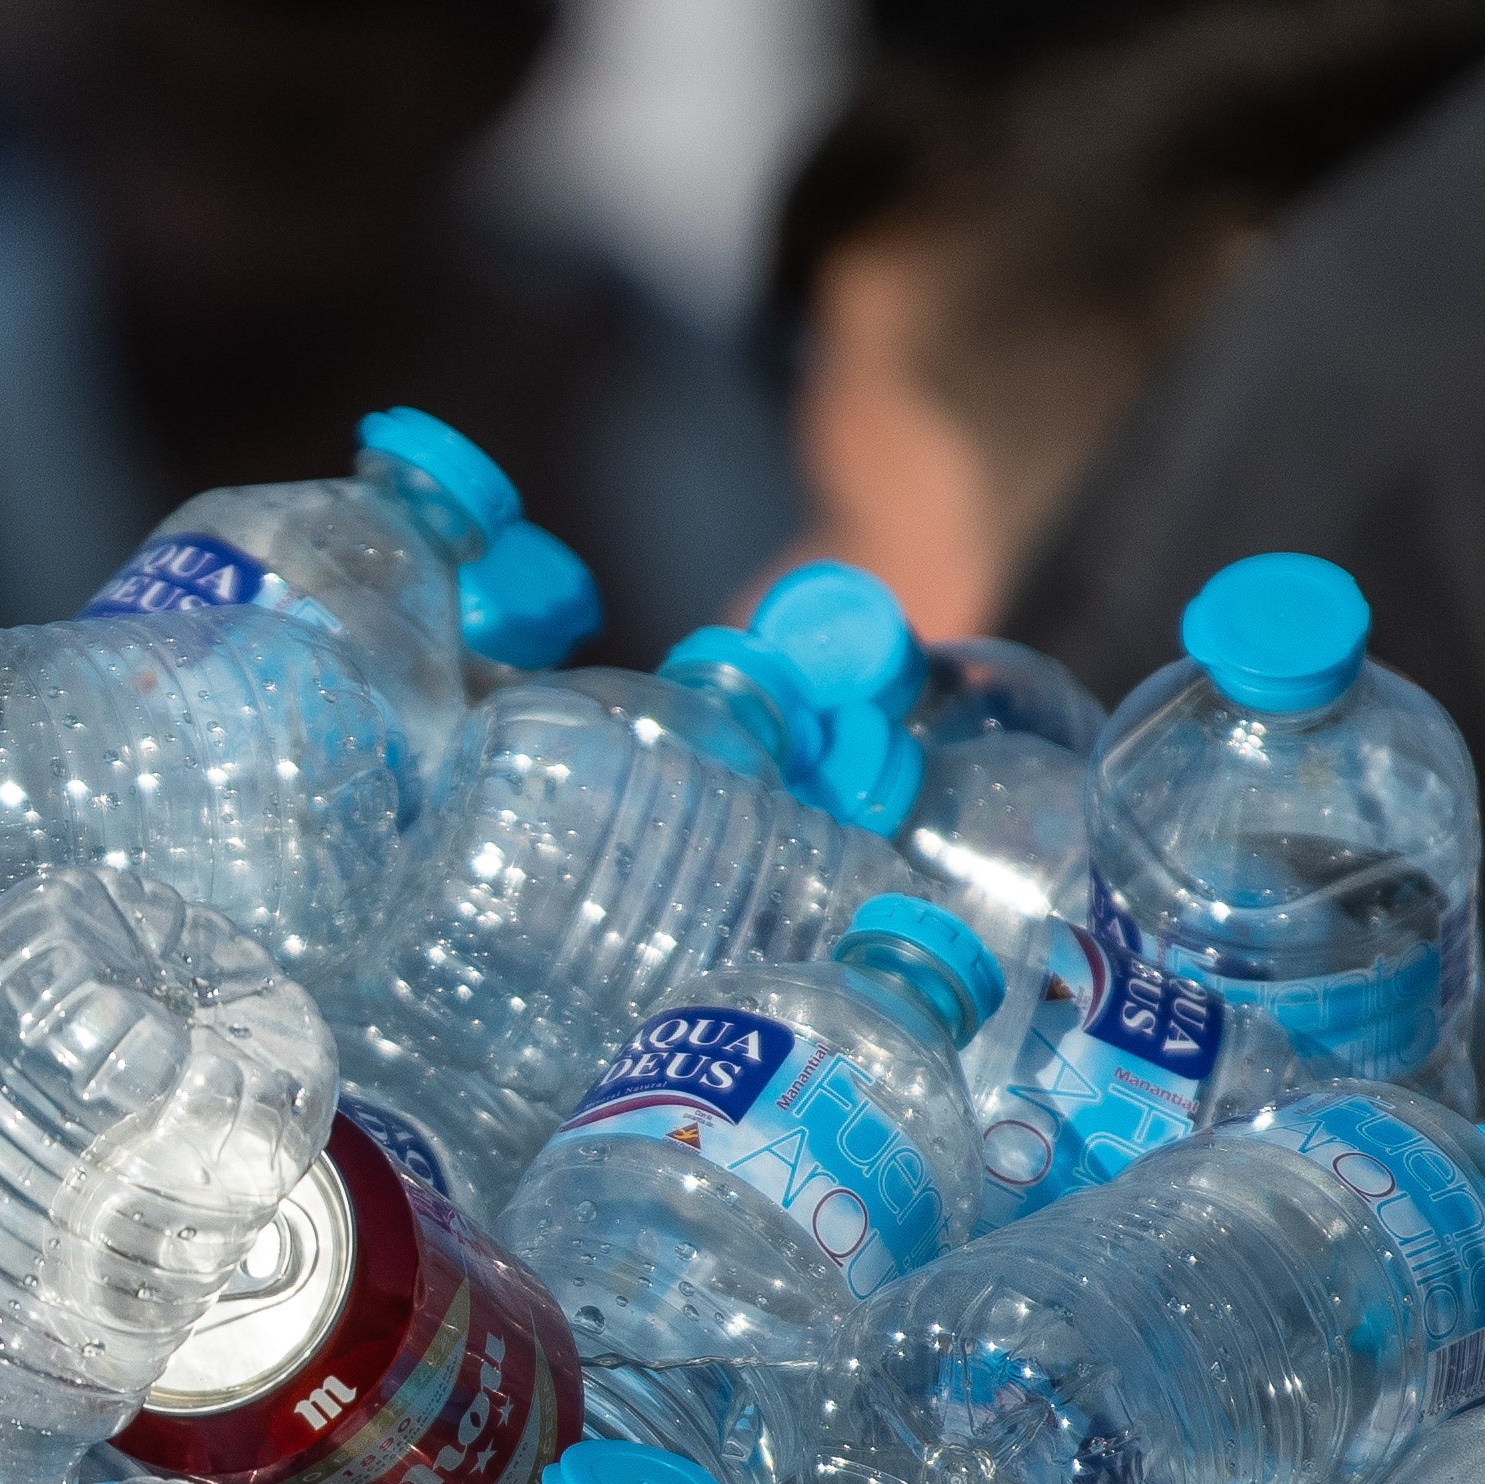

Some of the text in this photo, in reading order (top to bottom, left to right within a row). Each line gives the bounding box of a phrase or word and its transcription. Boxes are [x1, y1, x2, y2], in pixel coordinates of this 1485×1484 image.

[111, 572, 212, 621] EU
[140, 537, 242, 602] QUA
[598, 1040, 742, 1100] DEUS
[624, 1074, 667, 1102] Natural
[776, 1044, 830, 1111] Manantial
[293, 1375, 357, 1431] m
[342, 1416, 413, 1478] 1890
